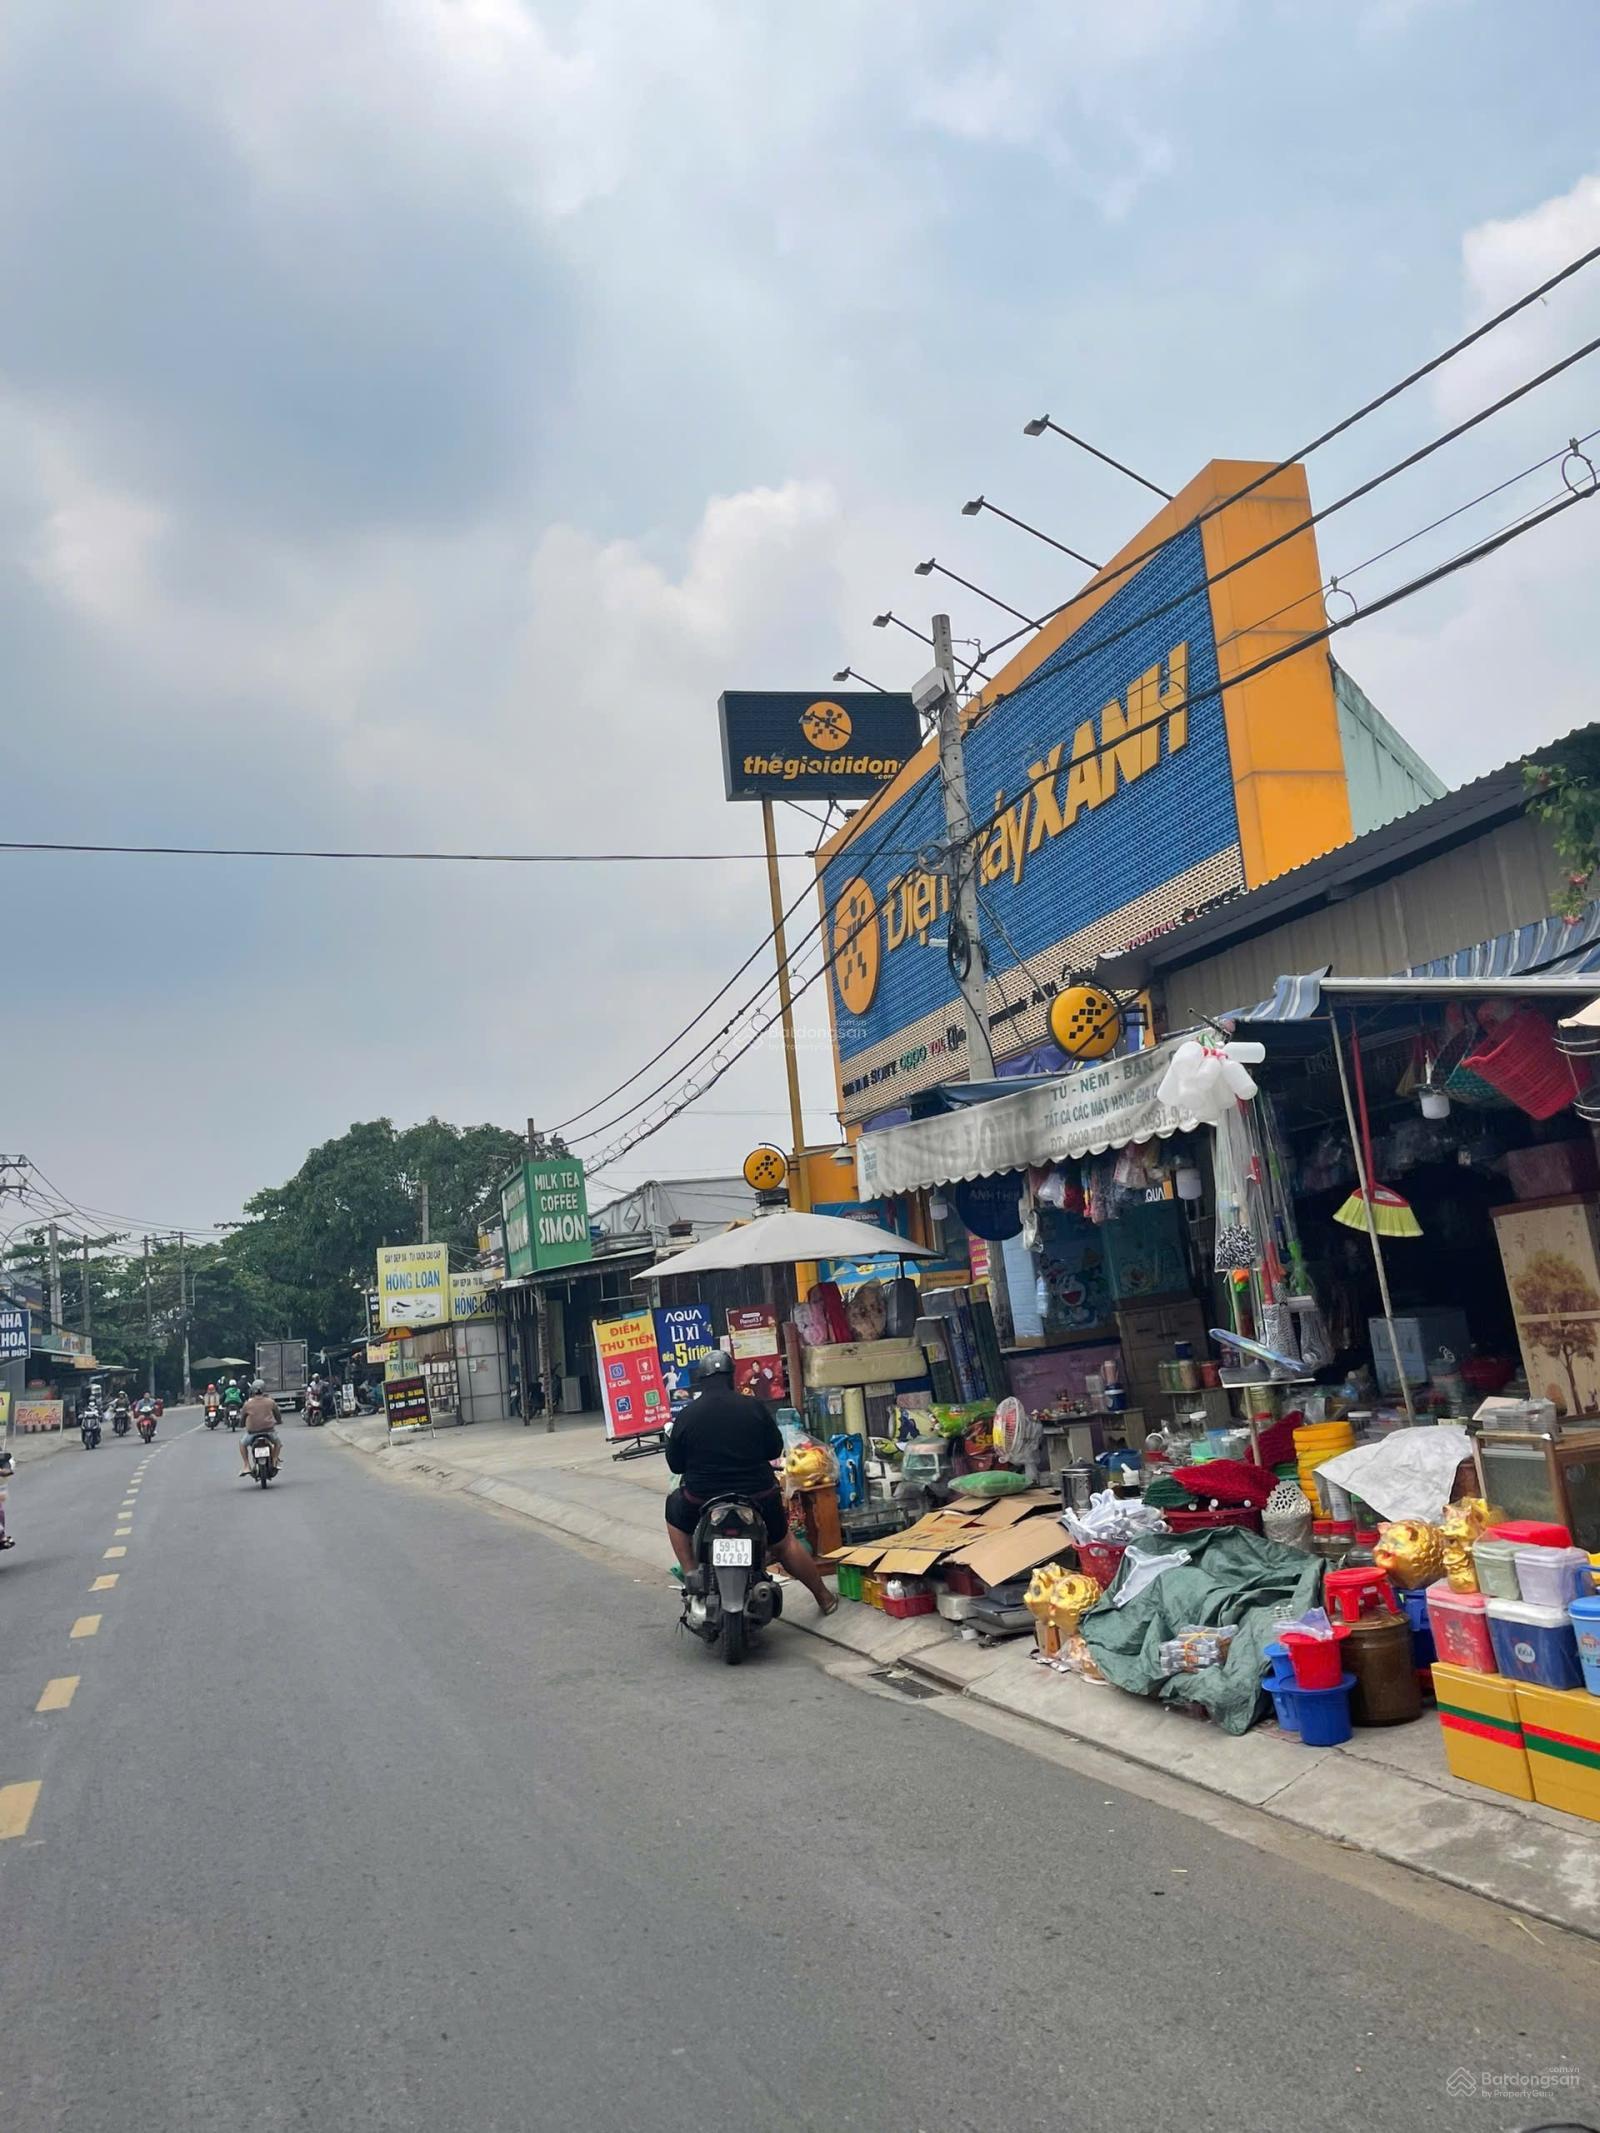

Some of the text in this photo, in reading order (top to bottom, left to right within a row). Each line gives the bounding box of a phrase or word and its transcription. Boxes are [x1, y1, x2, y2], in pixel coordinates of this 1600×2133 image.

[1080, 1071, 1110, 1093] NỆM
[534, 1171, 580, 1191] MILK TEA
[540, 1192, 579, 1213] COFFEE
[538, 1213, 587, 1245] SIMON
[415, 1269, 441, 1289] LOAN
[665, 1308, 703, 1324] AQUA
[0, 1331, 27, 1348] HOA
[610, 1322, 641, 1338] ĐIỂM
[601, 1339, 626, 1353] THU
[675, 1342, 689, 1367] 5
